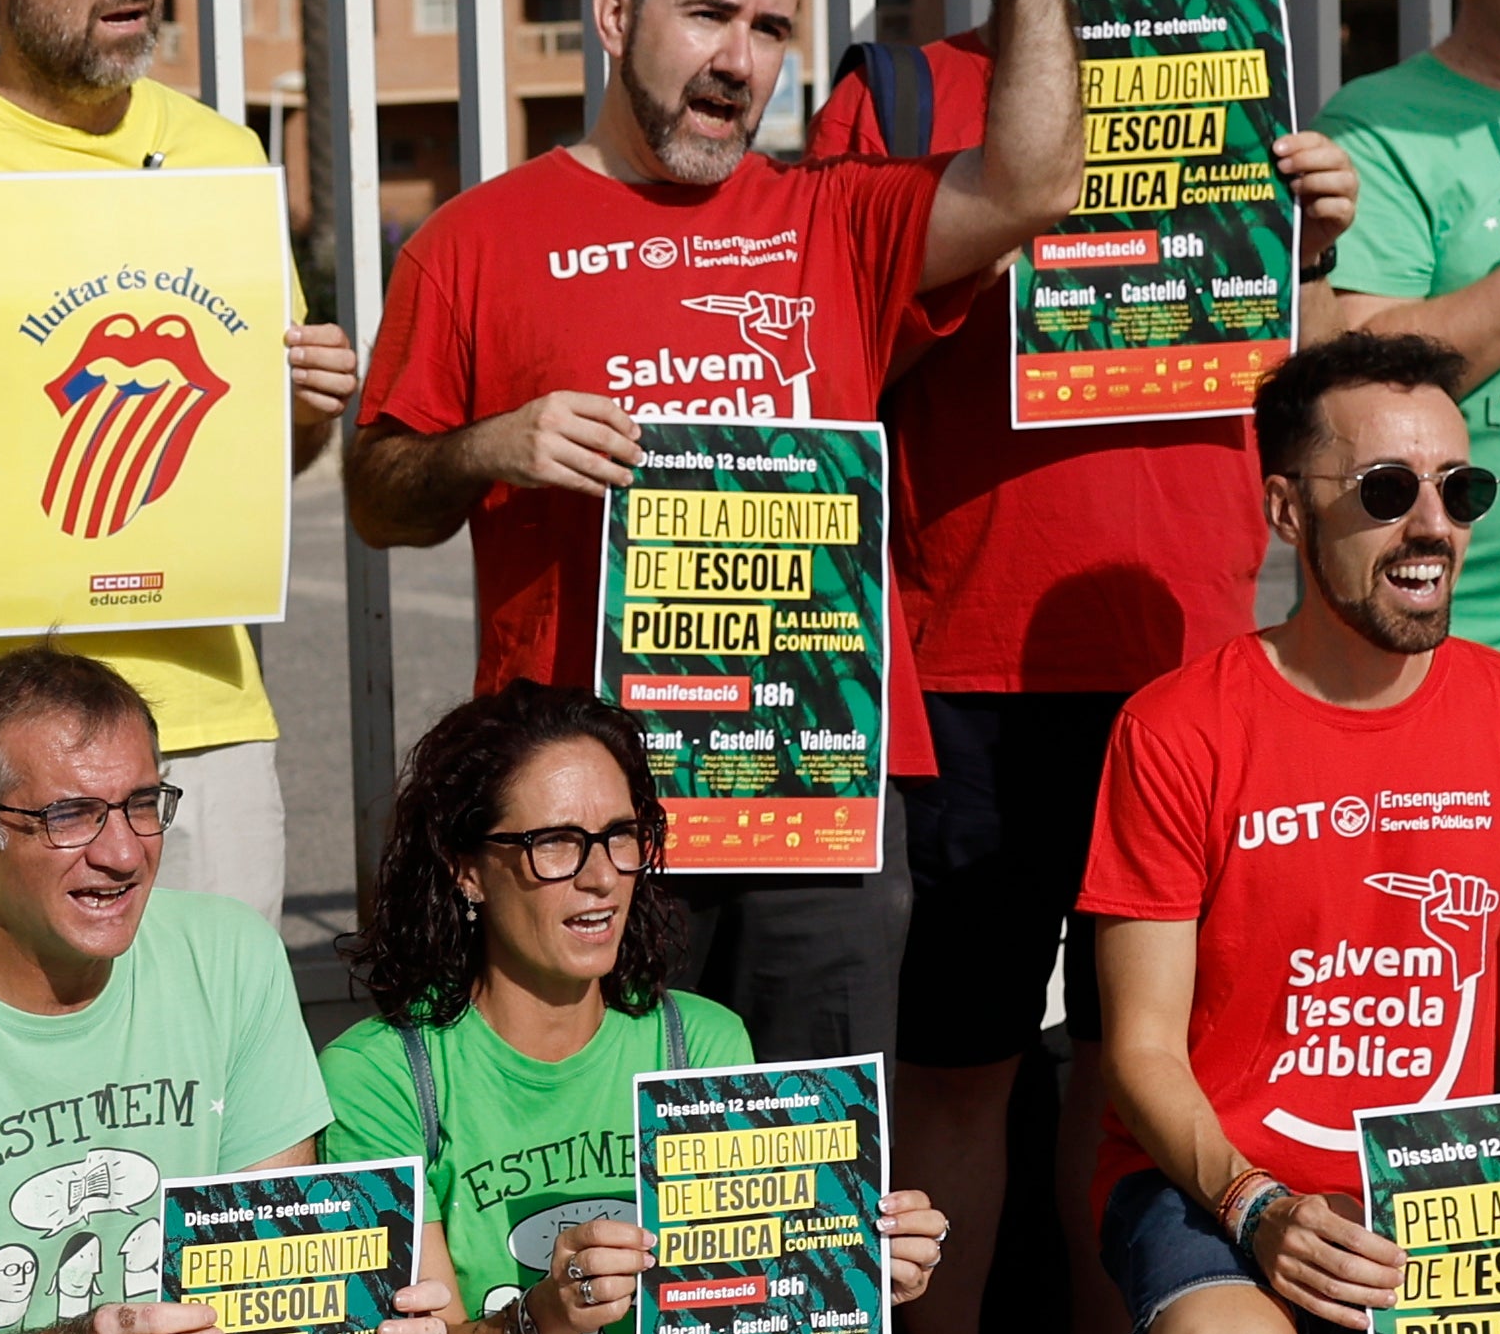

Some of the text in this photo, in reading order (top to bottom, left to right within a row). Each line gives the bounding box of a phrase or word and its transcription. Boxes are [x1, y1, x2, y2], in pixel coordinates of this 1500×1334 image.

[548, 241, 635, 280] UGT
[692, 229, 797, 255] Ensenyament
[693, 252, 740, 268] Serveis
[1043, 235, 1205, 262] Manifestació 18h
[18, 263, 250, 347] lluitar és educar
[606, 348, 764, 390] Salvem
[636, 497, 852, 541] PER LA DIGNITAT
[89, 591, 163, 607] educació
[92, 577, 140, 590] CCOO
[630, 683, 795, 707] Manifestació 18h
[1380, 789, 1491, 813] Ensenyament
[1238, 801, 1325, 850] UGT
[1380, 814, 1492, 833] Serveis Públics PV
[1288, 939, 1443, 987] Salvem
[1286, 986, 1444, 1036] l'escola
[1269, 1036, 1433, 1084] pública
[664, 1126, 850, 1174] PER LA DIGNITAT
[1387, 1139, 1478, 1169] Dissabte
[461, 1130, 636, 1213] ESTIME
[1402, 1194, 1461, 1245] PER
[188, 1234, 375, 1285] PER LA DIGNITAT
[1402, 1256, 1448, 1303] DE
[666, 1277, 805, 1304] Manifestació 18h
